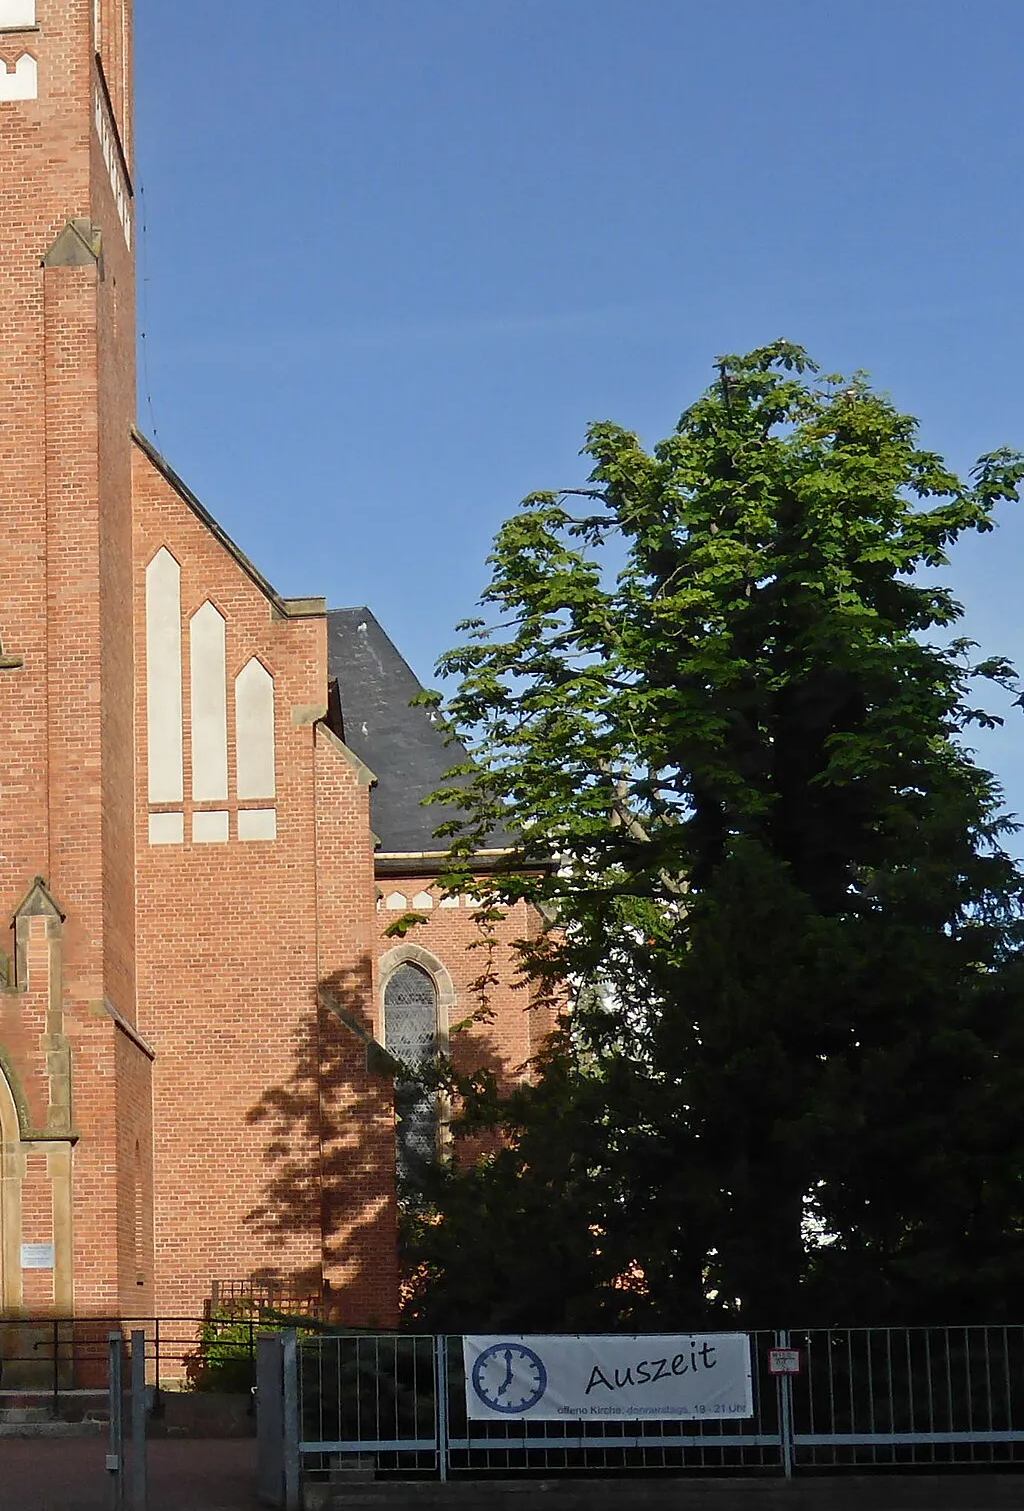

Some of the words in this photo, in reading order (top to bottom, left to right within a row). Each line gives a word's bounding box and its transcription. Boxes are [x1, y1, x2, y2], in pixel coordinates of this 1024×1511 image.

[584, 1341, 717, 1395] Auszeit
[557, 1405, 588, 1415] offene
[714, 1404, 726, 1414] 21
[728, 1403, 747, 1413] Uhr
